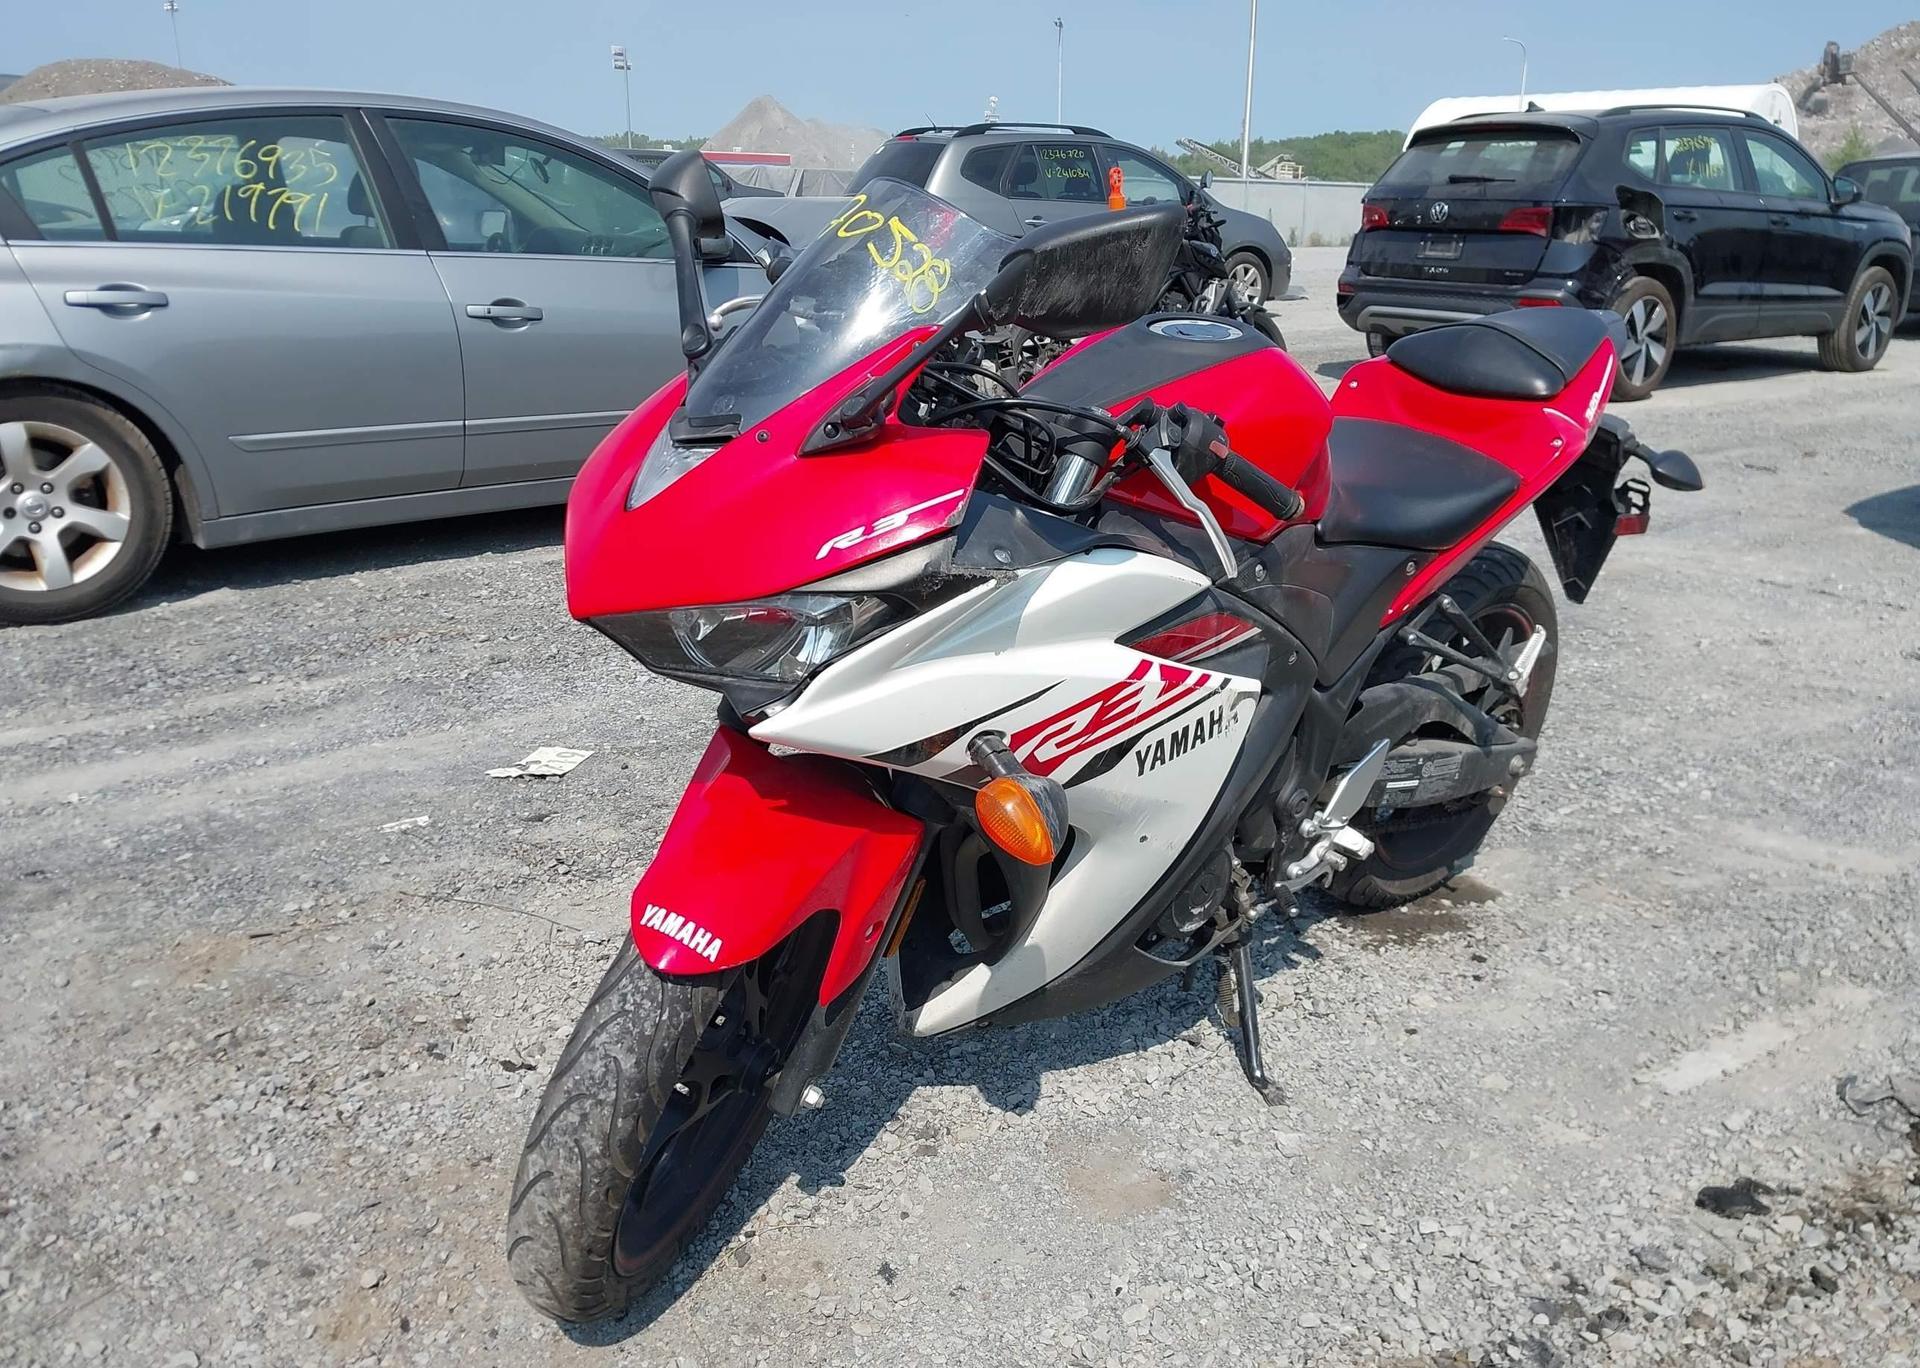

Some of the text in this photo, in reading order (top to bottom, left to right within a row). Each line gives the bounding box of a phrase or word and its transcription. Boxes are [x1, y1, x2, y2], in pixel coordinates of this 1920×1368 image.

[1039, 148, 1085, 160] 12376720
[815, 488, 965, 560] R3
[640, 903, 723, 963] YAMAHA
